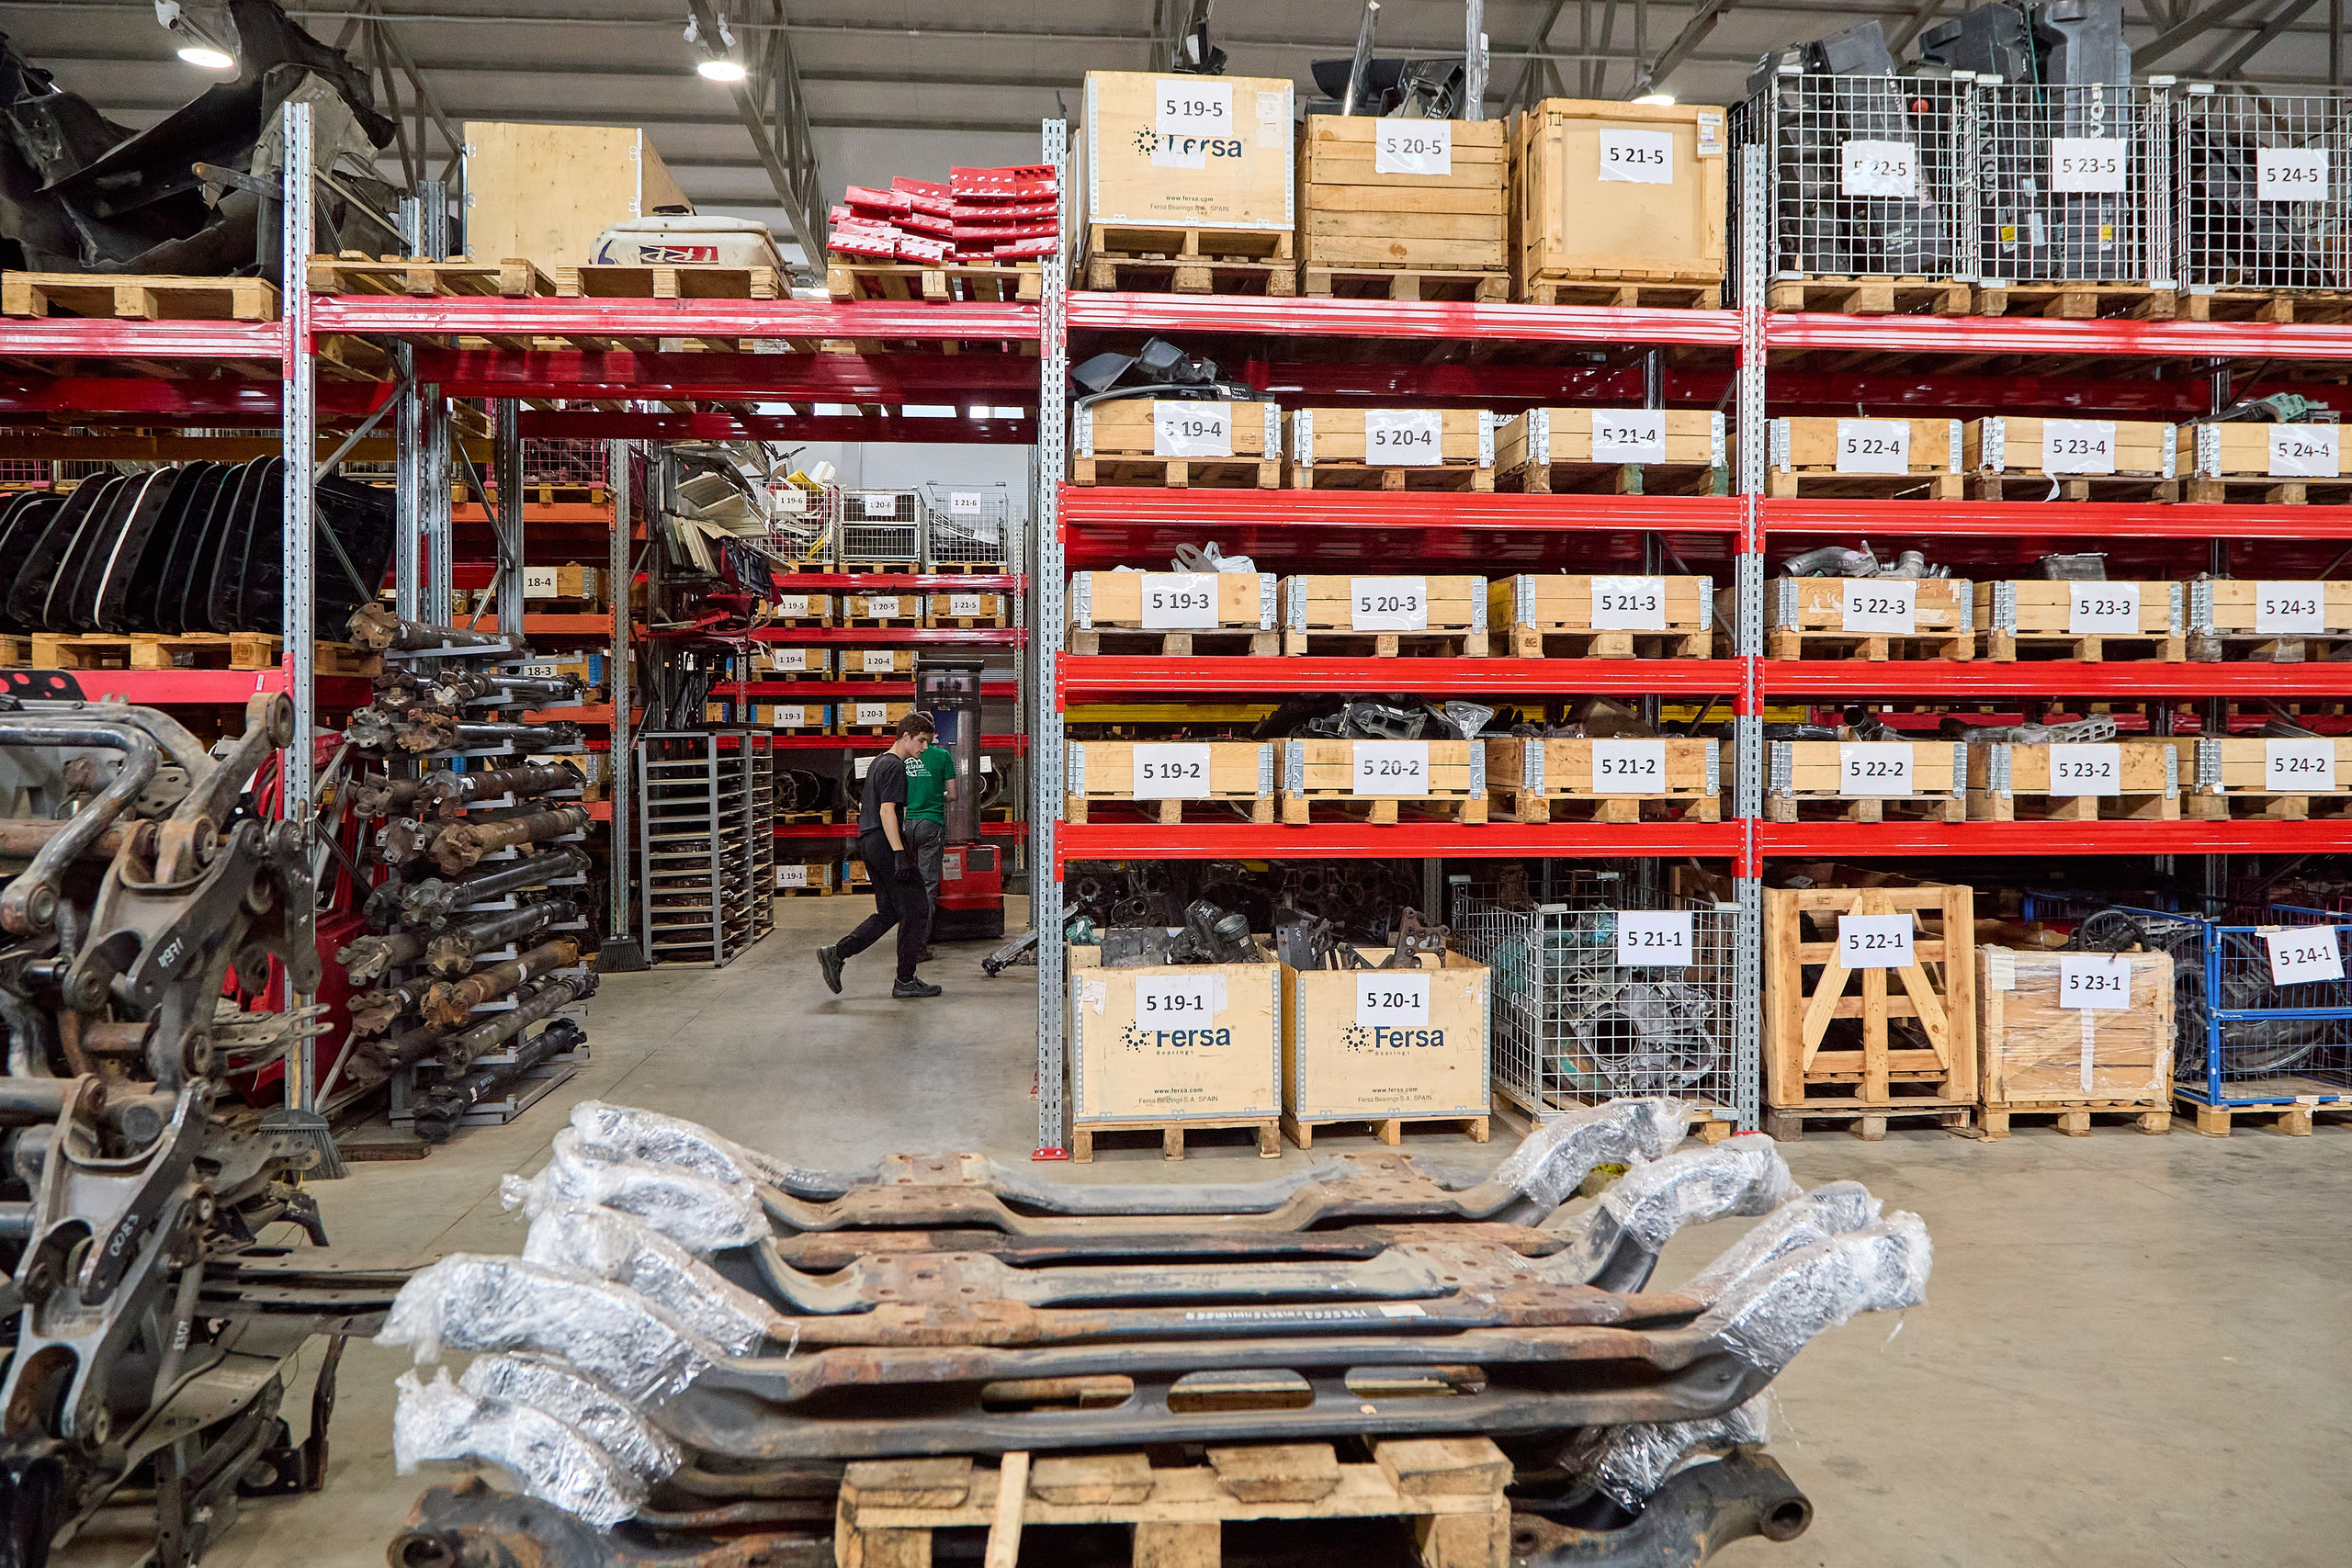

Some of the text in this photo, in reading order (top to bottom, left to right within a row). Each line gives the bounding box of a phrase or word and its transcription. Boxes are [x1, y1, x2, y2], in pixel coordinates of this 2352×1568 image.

[1166, 99, 1222, 117] 5 19-5
[1386, 138, 1442, 154] 5 20-5
[1610, 147, 1663, 164] 5 21-5
[1869, 160, 1906, 176] 22-5
[2063, 158, 2115, 173] 5 23-5
[2267, 167, 2317, 182] 5 24-5
[1165, 195, 1215, 203] www.fersa.com
[1168, 204, 1193, 212] Bearings
[1164, 421, 1221, 436] 5 19-4
[1602, 428, 1655, 443] 5 21-4
[1375, 430, 1431, 445] 5 20-4
[1847, 438, 1899, 455] 5 22-4
[2052, 439, 2106, 454] 5 23-4
[2278, 442, 2329, 457] 5 24-4
[960, 499, 978, 507] 21-6
[527, 577, 552, 587] 18-4
[788, 602, 805, 610] 19-5
[878, 603, 896, 611] 20-5
[1152, 593, 1208, 608] 5 19-3
[1361, 595, 1416, 612] 5 20-3
[1601, 595, 1656, 610] 5 21-3
[1852, 598, 1905, 614] 5 22-3
[2080, 600, 2130, 615] 5 23-3
[2266, 600, 2315, 614] 5 24-3
[527, 666, 552, 676] 18-3
[1143, 762, 1200, 778] 5 19-2
[1363, 760, 1419, 775] 5 20-2
[1601, 759, 1655, 773] 5 21-2
[1850, 761, 1903, 775] 5 22-2
[2059, 762, 2109, 777] 5 23-2
[2275, 757, 2325, 772] 5 24-2
[786, 872, 803, 880] 19-1
[1627, 931, 1682, 946] 5 21-1
[1849, 933, 1903, 949] 5 22-1
[2279, 945, 2331, 964] 5 24-1
[2069, 975, 2120, 990] 5 23-1
[1146, 995, 1203, 1010] 5 19-1
[1367, 992, 1419, 1007] 5 20-1
[1156, 1027, 1231, 1048] Fersa
[1374, 1025, 1444, 1049] Fersa
[1138, 1097, 1156, 1105] Fersa
[1198, 1095, 1218, 1103] SPAIN
[1374, 1095, 1400, 1103] Bearings
